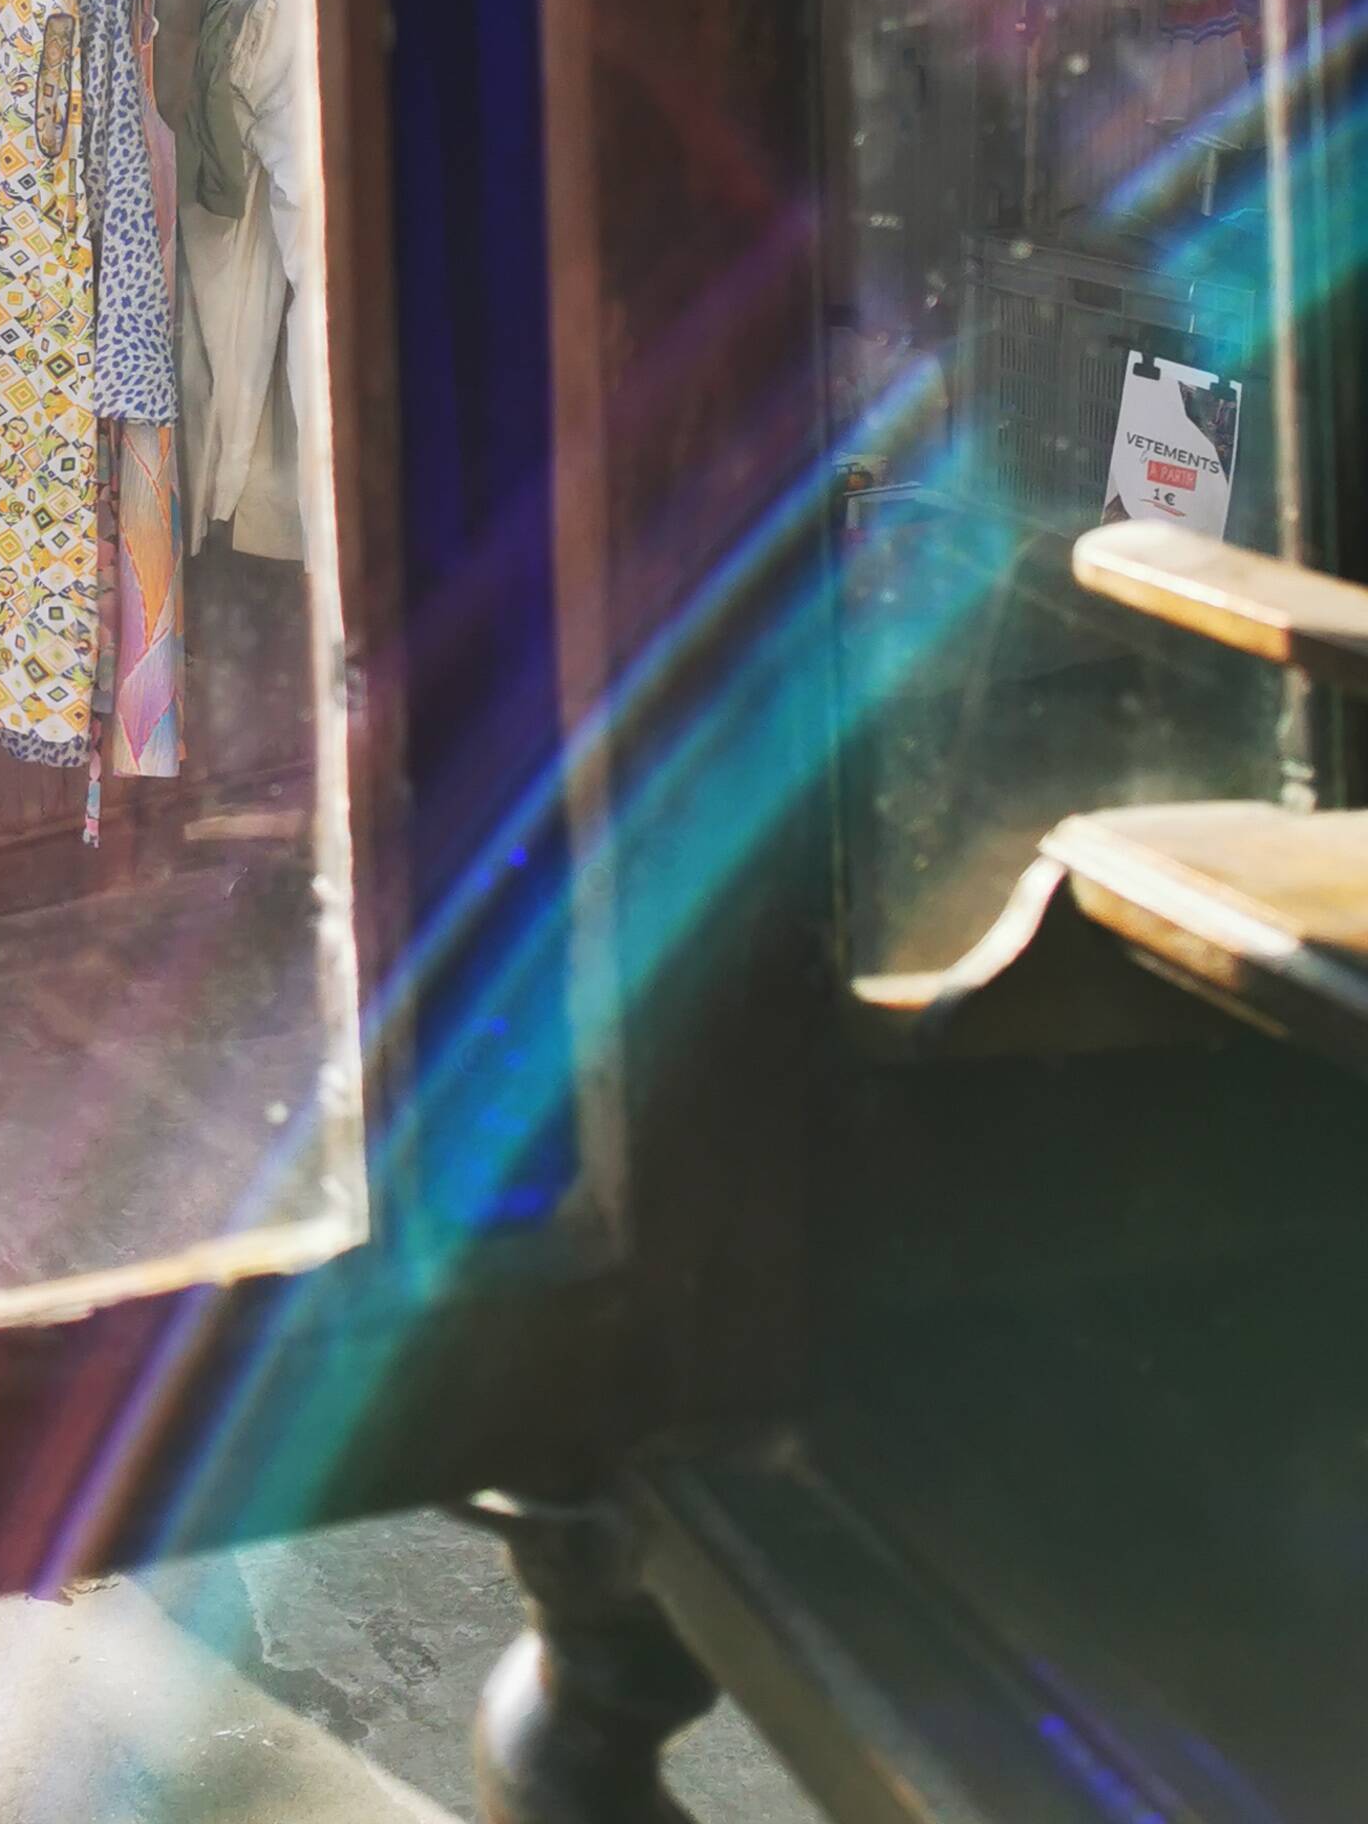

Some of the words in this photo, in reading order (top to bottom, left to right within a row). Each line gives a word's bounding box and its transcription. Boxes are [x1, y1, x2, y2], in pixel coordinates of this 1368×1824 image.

[1126, 431, 1220, 474] VETEMENTS
[1152, 487, 1160, 501] 1
[1164, 492, 1176, 506] €
